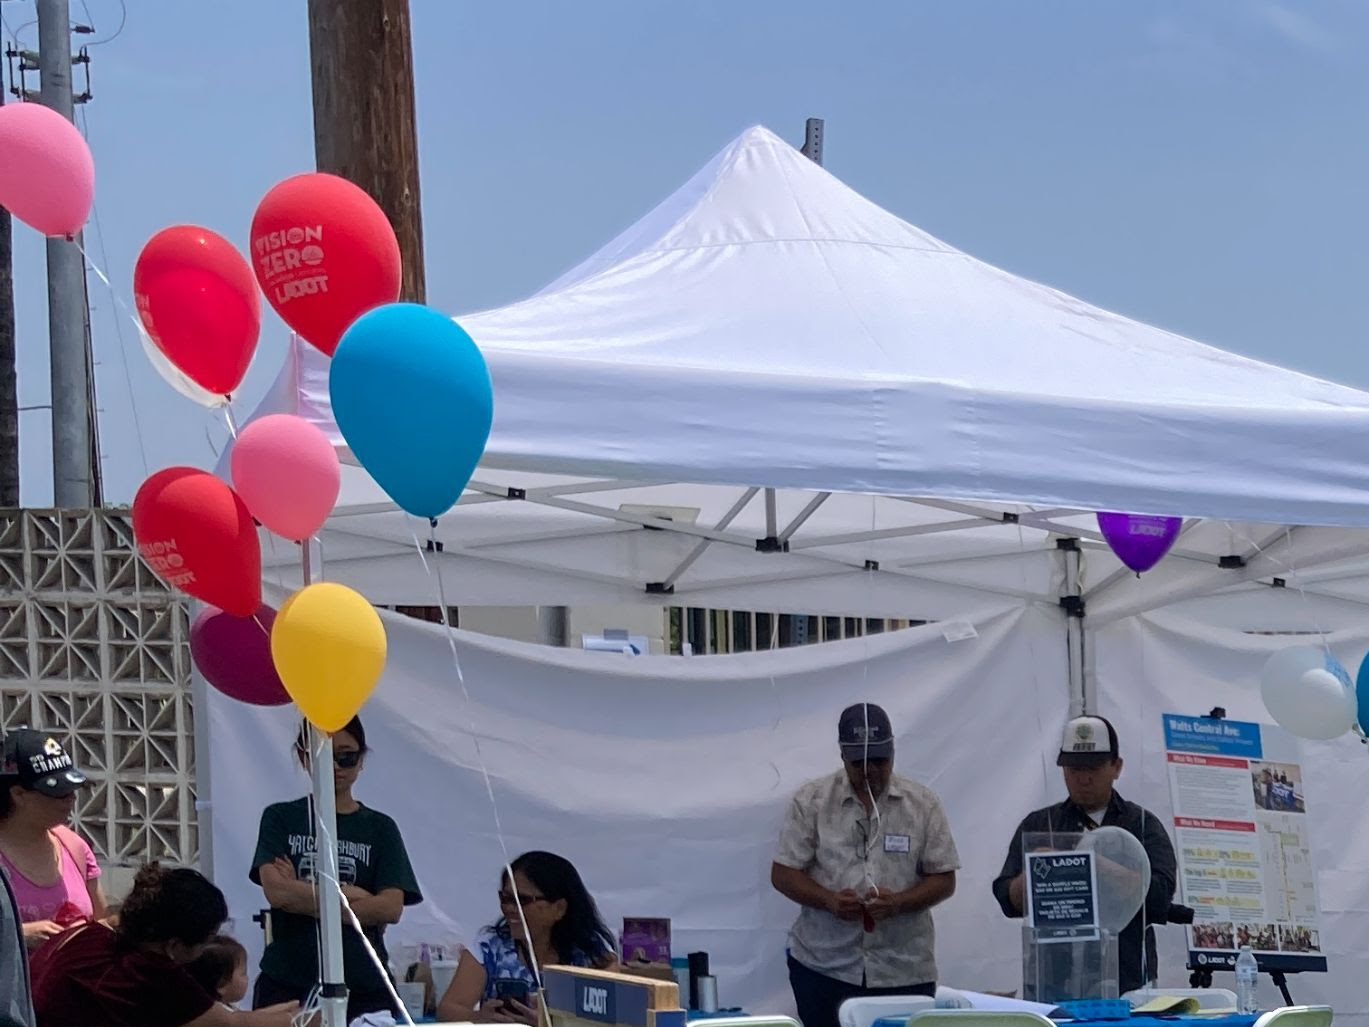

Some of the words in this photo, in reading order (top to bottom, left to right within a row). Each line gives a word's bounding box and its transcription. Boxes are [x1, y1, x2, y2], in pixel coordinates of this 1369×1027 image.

[255, 225, 323, 256] VISION
[260, 245, 324, 280] ZERO
[1168, 719, 1192, 732] Watts
[1193, 722, 1222, 735] Central
[1052, 857, 1087, 868] LADOT
